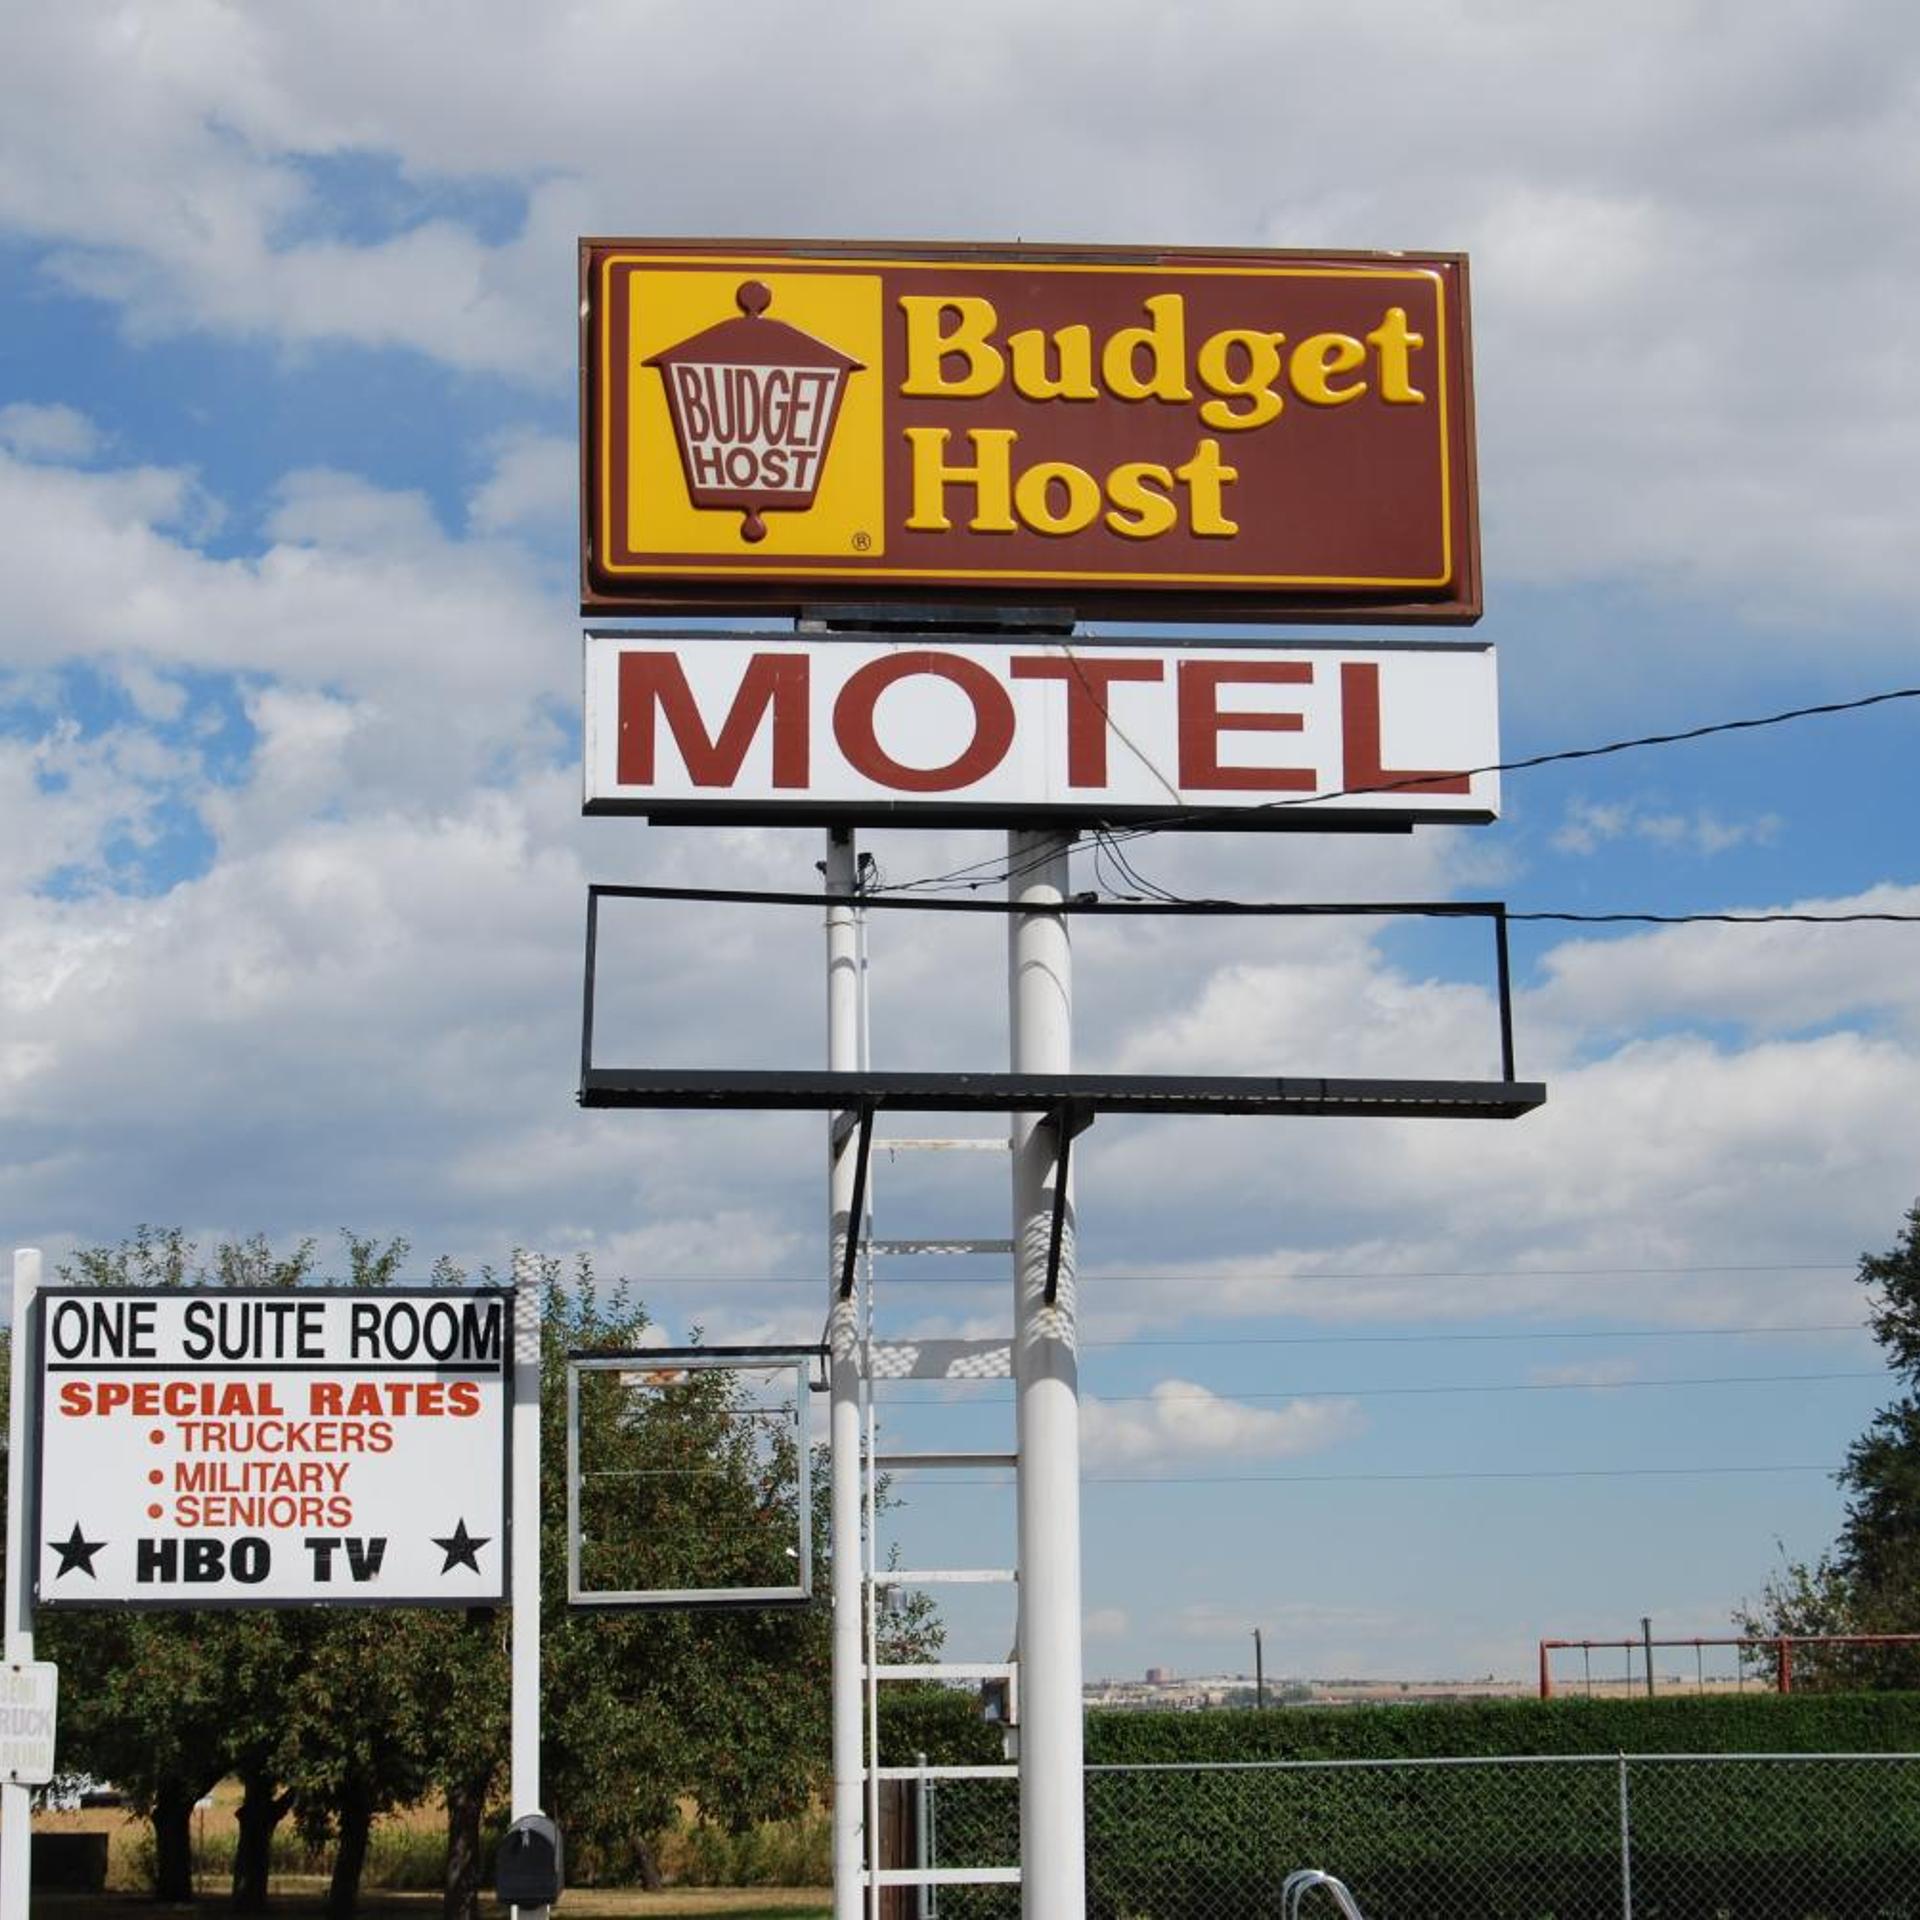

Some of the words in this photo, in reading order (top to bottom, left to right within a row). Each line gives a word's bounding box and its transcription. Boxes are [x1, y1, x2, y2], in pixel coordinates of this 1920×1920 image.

[899, 293, 1427, 432] Budget
[676, 366, 835, 447] BUDGET
[692, 446, 817, 488] HOST
[904, 427, 1240, 539] Host
[618, 650, 1470, 795] MOTEL
[52, 1301, 157, 1360] ONE
[183, 1302, 325, 1361] SUITE
[351, 1304, 501, 1360] ROOM
[60, 1382, 284, 1417] SPECIAL
[310, 1382, 481, 1417] RATES
[177, 1421, 394, 1454] TRUCKERS
[174, 1462, 350, 1493] MILITARY
[175, 1495, 354, 1528] SENIORS
[136, 1537, 272, 1584] HBO
[304, 1537, 388, 1583] TV
[0, 1707, 52, 1737] RUCK
